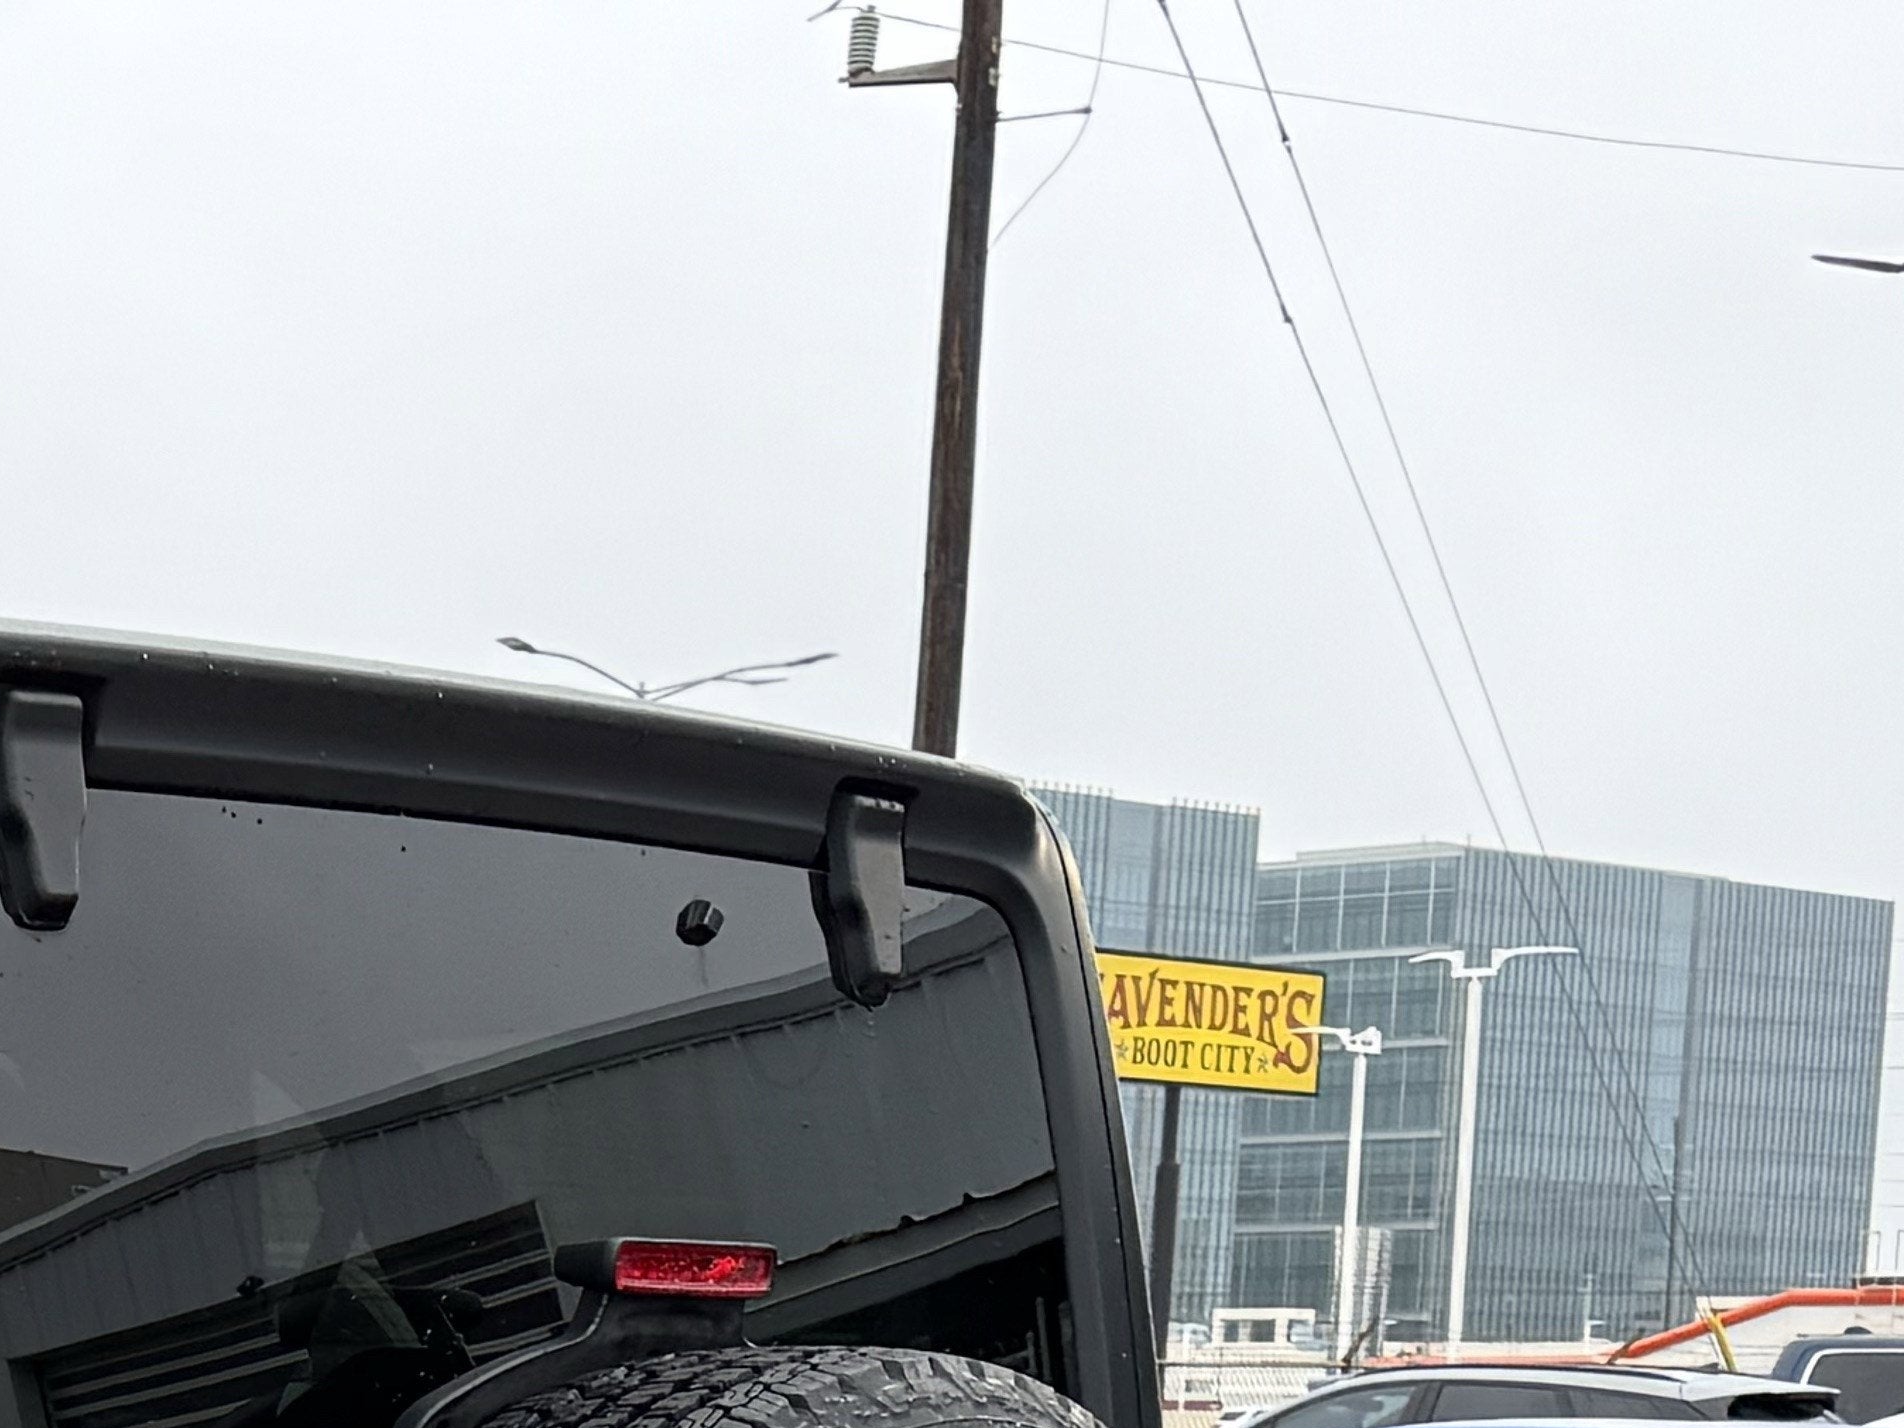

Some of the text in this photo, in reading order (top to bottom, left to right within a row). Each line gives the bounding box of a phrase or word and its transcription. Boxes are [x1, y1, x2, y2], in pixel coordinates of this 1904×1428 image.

[1098, 966, 1316, 1074] AVENDER'S
[1132, 1036, 1255, 1075] BOOT CITY
